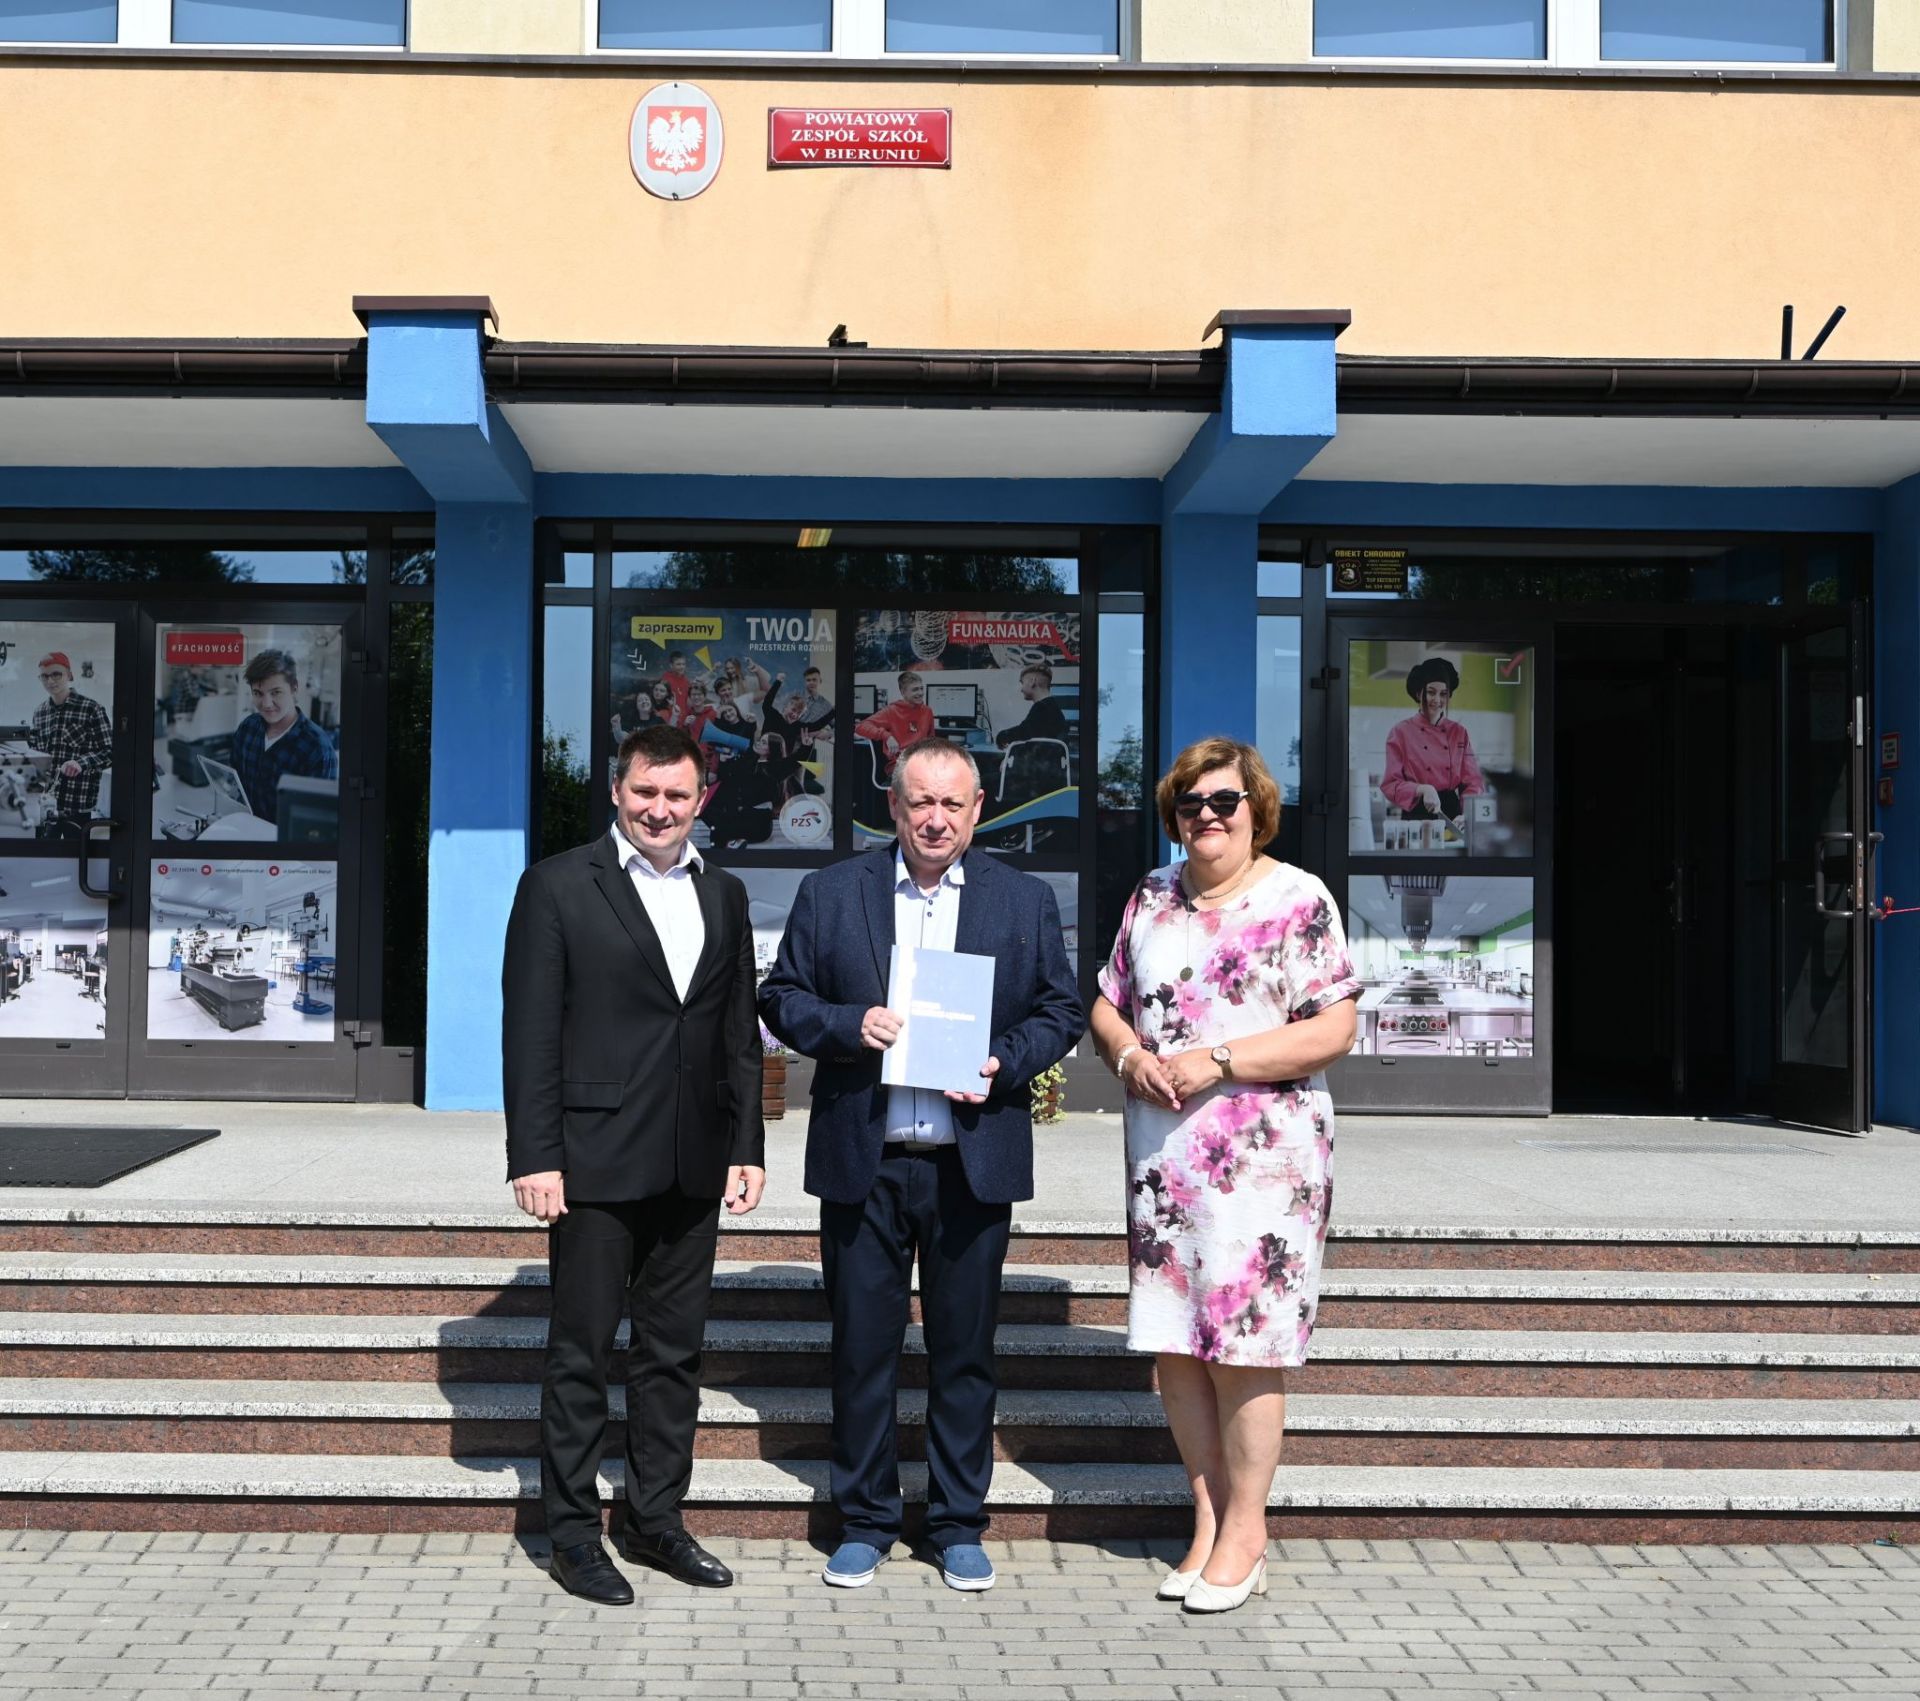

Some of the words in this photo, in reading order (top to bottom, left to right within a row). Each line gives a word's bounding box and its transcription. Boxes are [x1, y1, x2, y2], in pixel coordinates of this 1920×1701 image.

[804, 112, 919, 126] POWIATOWY
[791, 128, 860, 142] ZESPÓŁ
[868, 129, 928, 143] SZKÓŁ
[800, 148, 819, 159] W
[824, 148, 921, 161] BIERUNIU
[1335, 550, 1361, 558] OBIEKT
[1363, 550, 1406, 558] CHRONIONY
[638, 622, 715, 636] zapraszamy
[746, 617, 833, 642] TWOJA
[952, 622, 1052, 638] FUN&NAUKA
[171, 642, 240, 653] #FACHOWOŚĆ
[749, 642, 796, 651] PRZESTRZEŃ
[798, 643, 833, 652] ROZWOJU
[1482, 805, 1491, 817] 3
[791, 817, 811, 827] PZS
